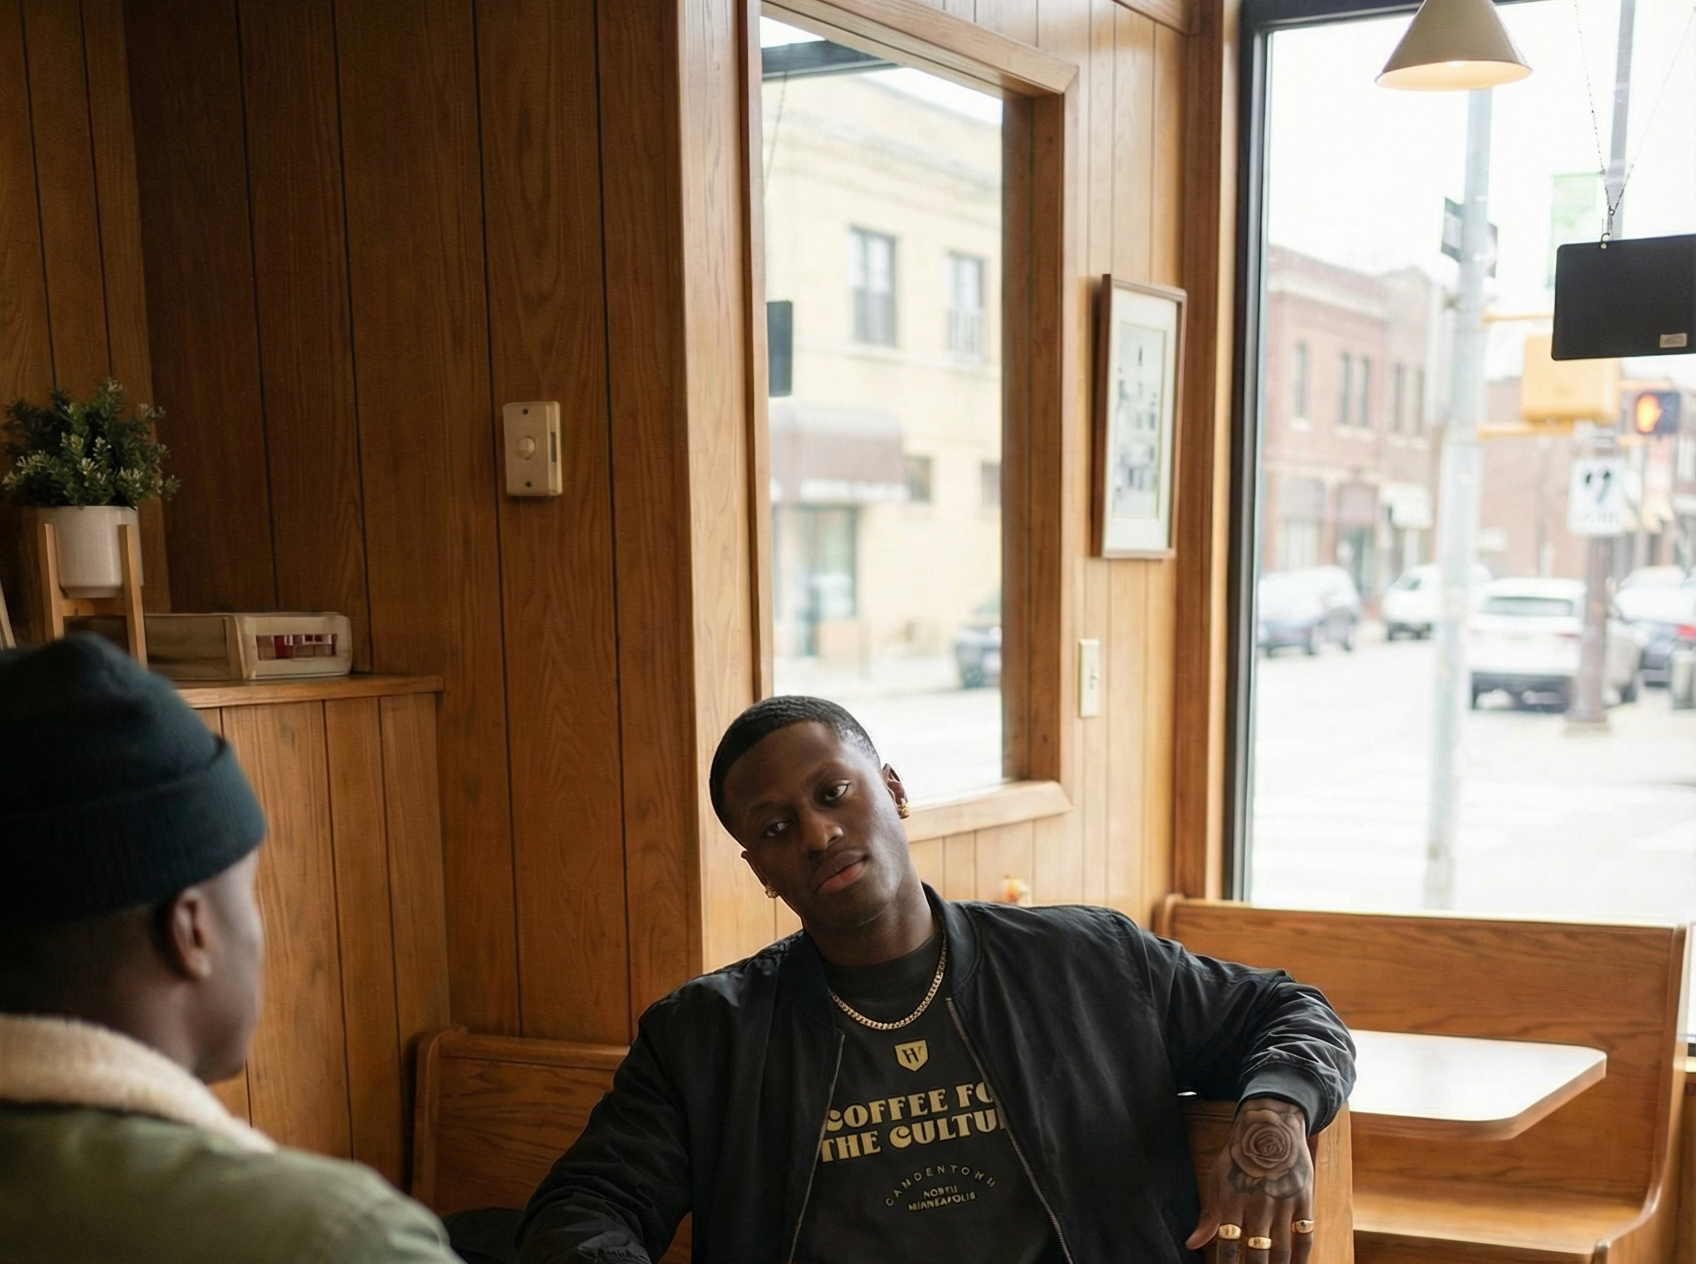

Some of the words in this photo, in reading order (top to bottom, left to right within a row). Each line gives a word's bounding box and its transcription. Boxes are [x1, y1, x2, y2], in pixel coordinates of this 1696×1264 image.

[826, 1088, 948, 1132] COFFEE
[821, 1130, 881, 1163] THE
[889, 1109, 1004, 1149] CULTU
[885, 1164, 996, 1207] CAMDENTOWN
